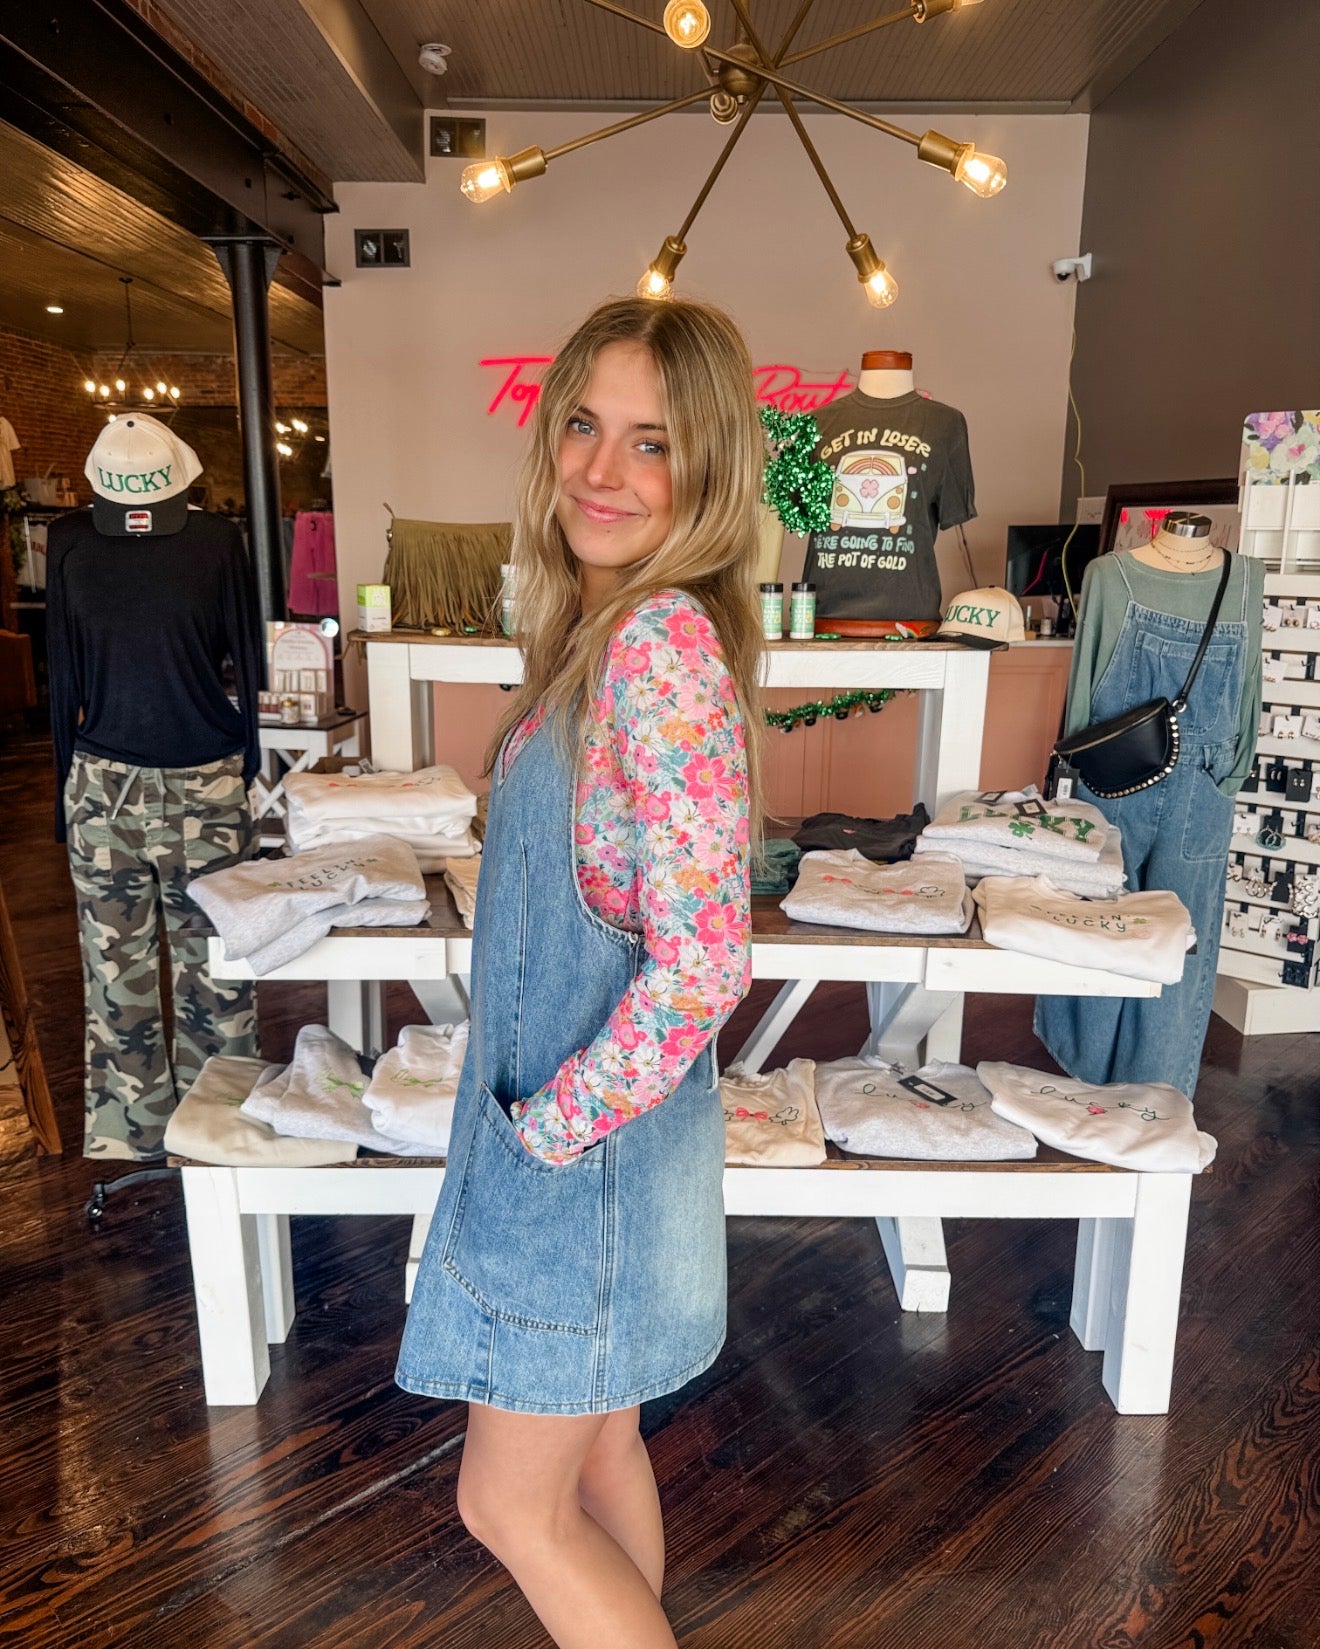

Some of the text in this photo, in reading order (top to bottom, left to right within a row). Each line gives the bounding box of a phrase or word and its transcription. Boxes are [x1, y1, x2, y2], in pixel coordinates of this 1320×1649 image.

[820, 428, 932, 460] GET IN LOSER
[98, 464, 172, 493] LUCKY
[840, 534, 878, 551] GOING
[881, 536, 893, 551] TO
[895, 537, 915, 554] FIND
[817, 551, 907, 571] THE POT OF GOLD
